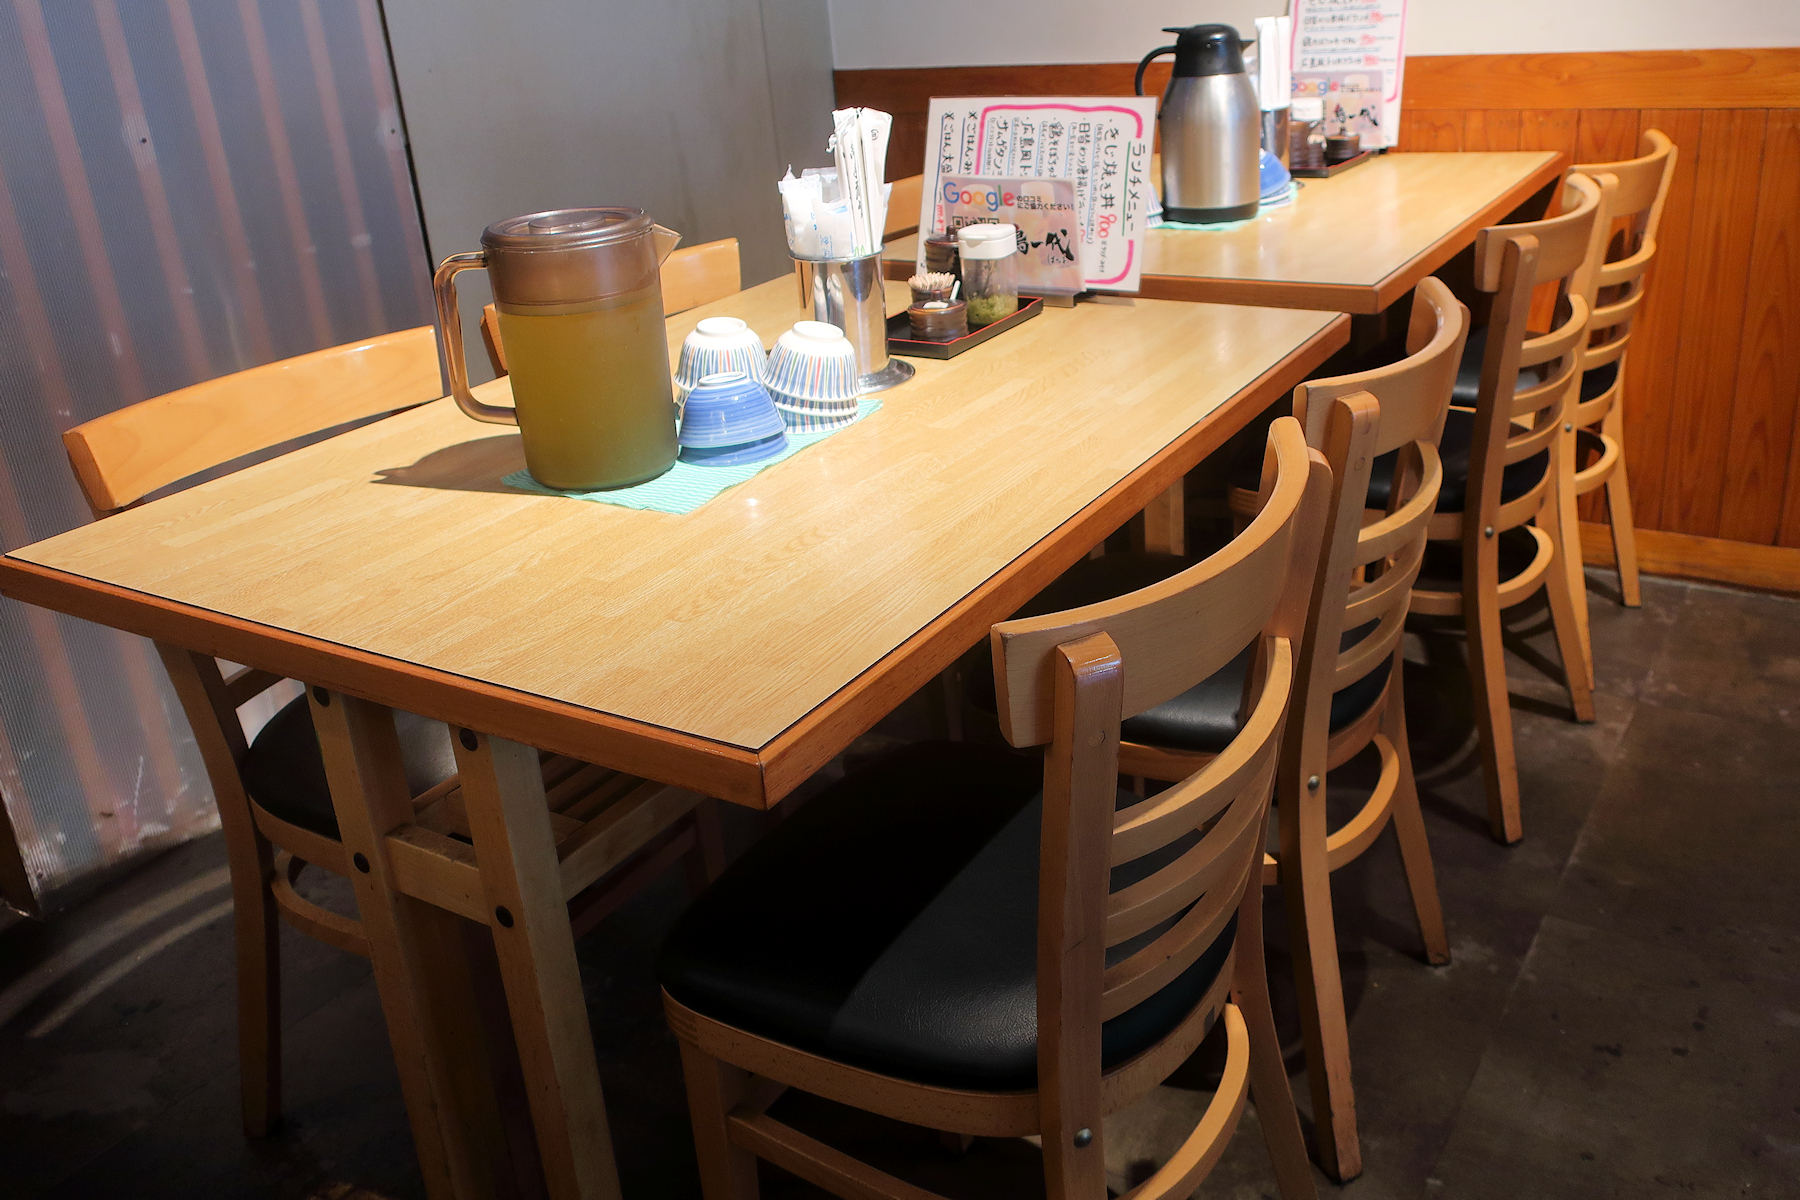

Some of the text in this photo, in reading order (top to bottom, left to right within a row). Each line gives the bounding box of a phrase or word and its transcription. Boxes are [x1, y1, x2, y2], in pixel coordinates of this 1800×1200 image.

[1099, 127, 1120, 210] きじ焼き丼
[943, 181, 1015, 212] Google
[1016, 195, 1042, 203] の口コミ
[1126, 143, 1146, 231] ランチメニュー
[1098, 213, 1117, 239] 900
